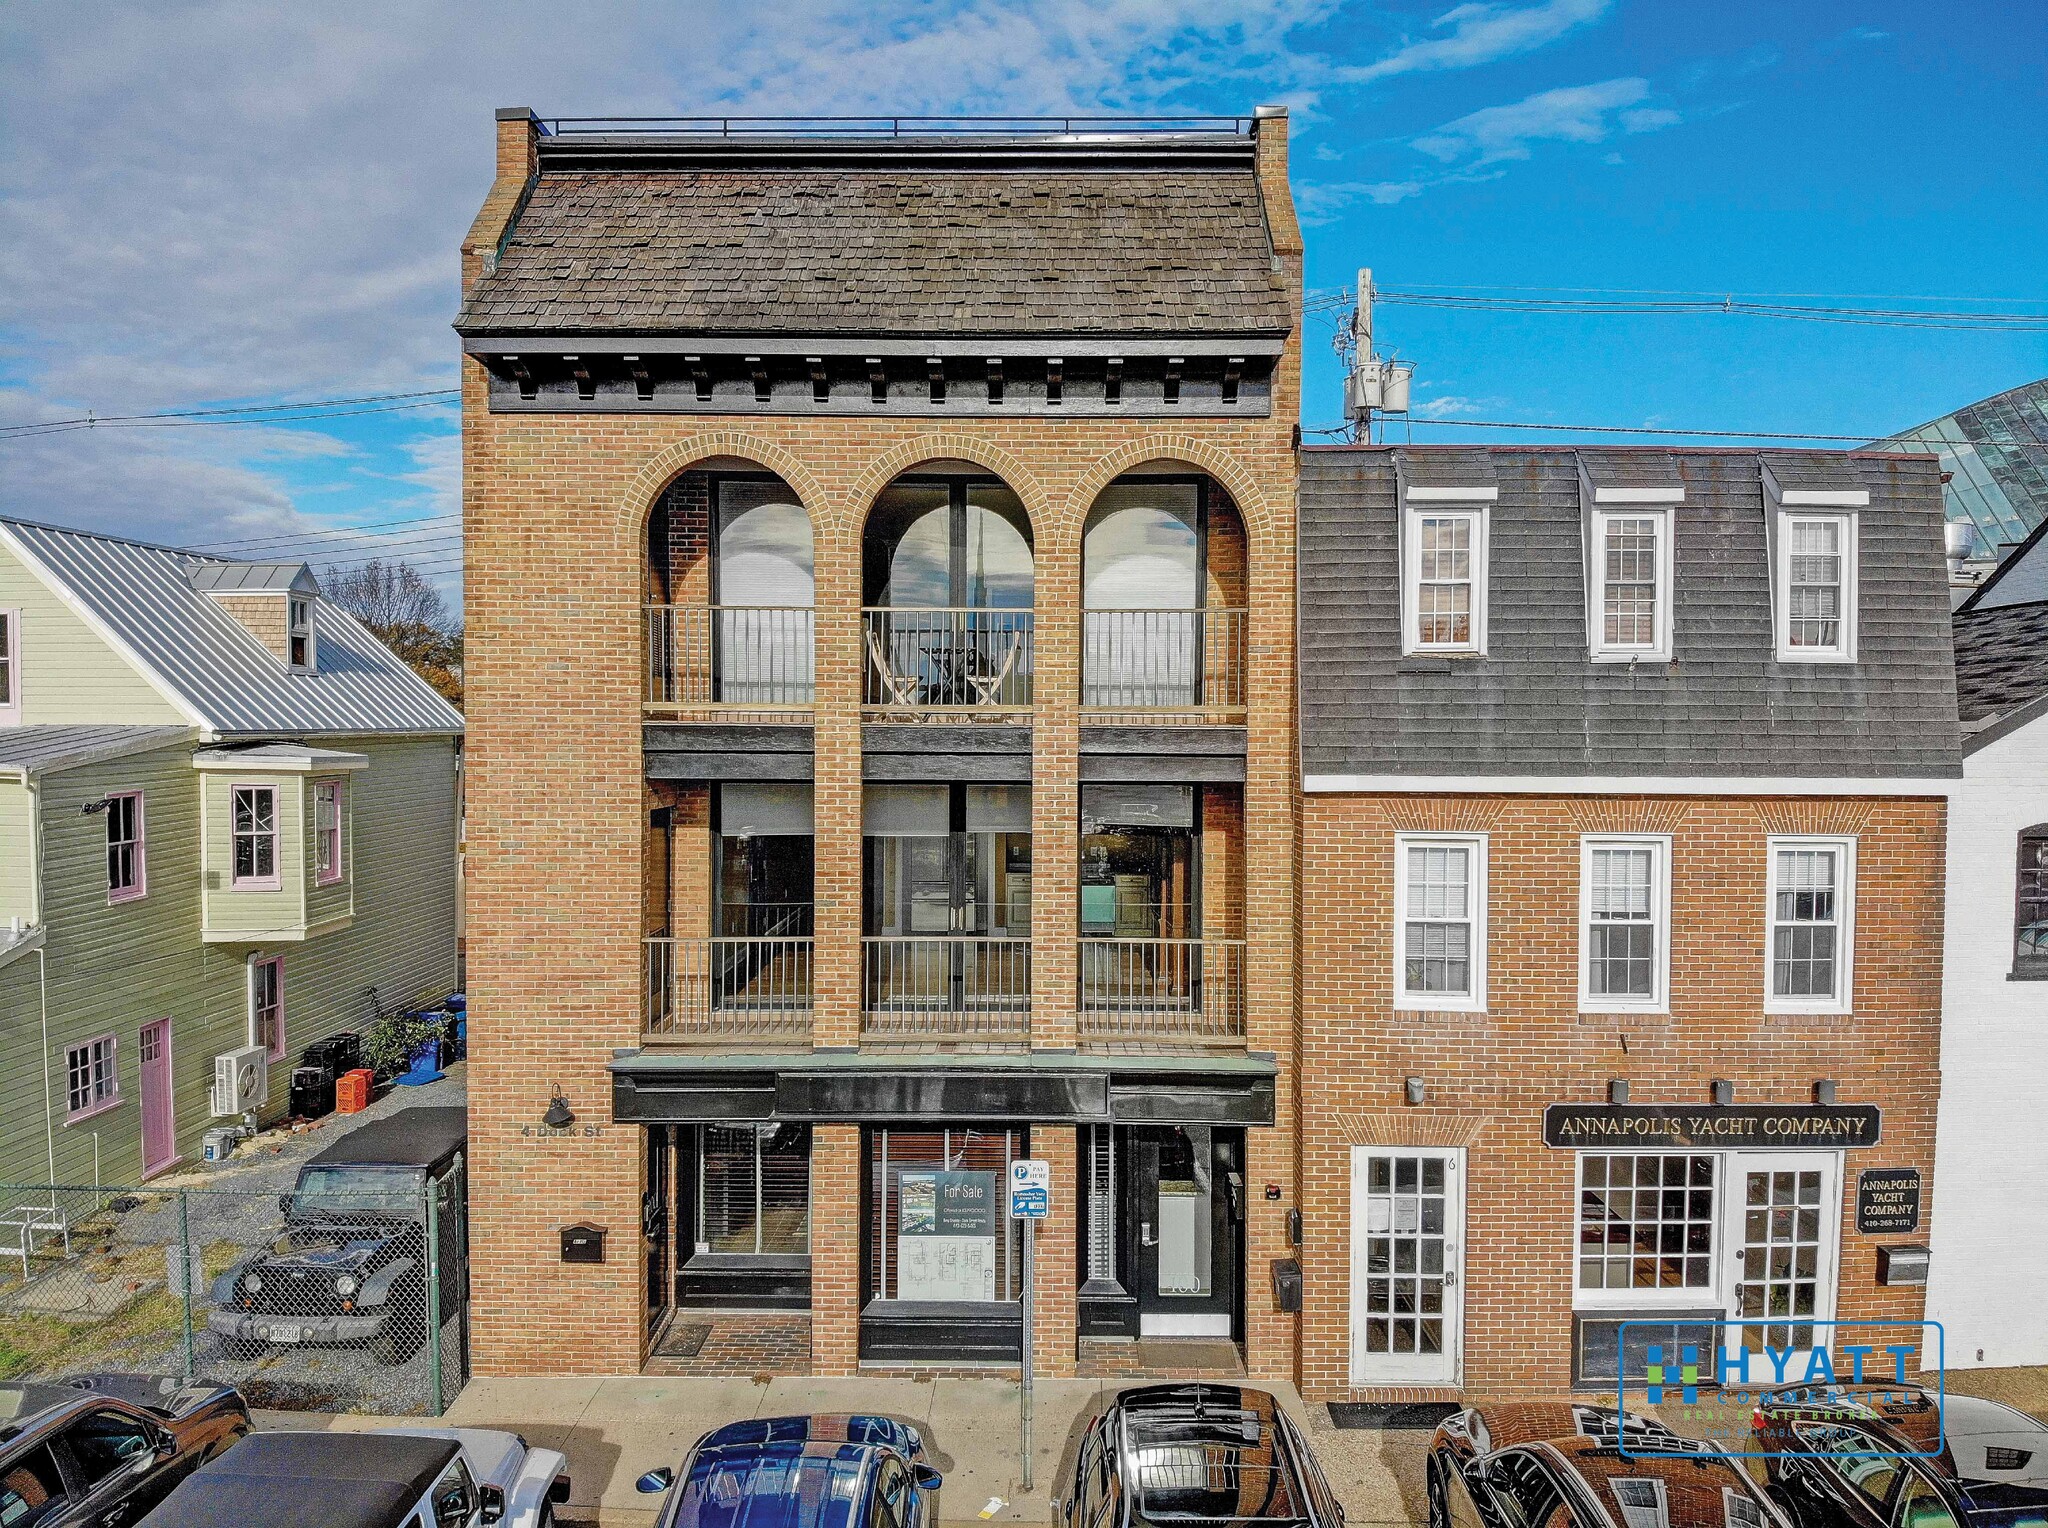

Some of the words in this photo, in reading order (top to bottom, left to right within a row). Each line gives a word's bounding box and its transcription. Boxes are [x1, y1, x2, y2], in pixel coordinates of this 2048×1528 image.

[521, 1125, 530, 1137] 4
[537, 1125, 577, 1137] Dock
[584, 1125, 602, 1137] St
[1559, 1117, 1682, 1135] ANNAPOLIS
[1687, 1117, 1758, 1135] YACHT
[1763, 1117, 1868, 1135] COMPANY
[1448, 1157, 1456, 1170] 6
[1017, 1167, 1026, 1179] P
[944, 1184, 961, 1198] For
[962, 1184, 983, 1198] Sale
[1862, 1180, 1918, 1190] ANNAPOLIS
[1872, 1193, 1905, 1202] YACHT
[1864, 1204, 1914, 1216] COMPANY
